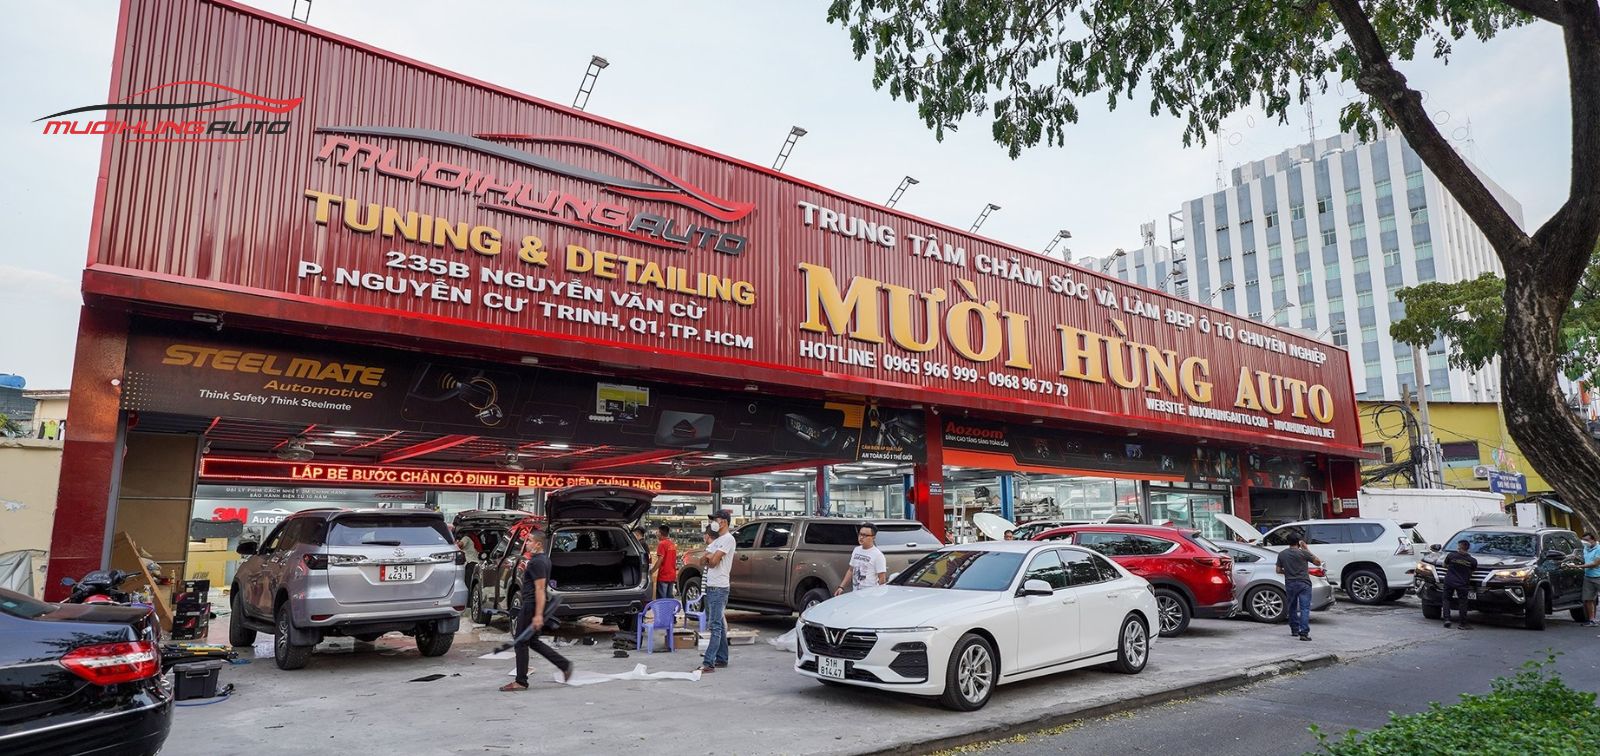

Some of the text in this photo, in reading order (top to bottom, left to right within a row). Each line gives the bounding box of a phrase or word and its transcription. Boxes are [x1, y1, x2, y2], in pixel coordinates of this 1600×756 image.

[304, 189, 756, 307] TUNING & DETAILING
[386, 251, 708, 320] 235B NGUYỄN VĂN CỪ
[798, 200, 896, 248] TRUNG
[907, 233, 966, 268] TÂM
[975, 256, 1043, 288] CHĂM
[1095, 285, 1120, 311] VÀ
[1123, 295, 1160, 321] LÀM
[1164, 309, 1195, 332] ĐẸP
[1199, 315, 1211, 335] Ô
[1214, 321, 1235, 341] TÔ
[1237, 329, 1288, 355] CHUYÊN
[1289, 343, 1328, 368] NGHIỆP
[298, 260, 327, 282] P.
[335, 267, 472, 305] NGUYỄN
[483, 292, 529, 313] CƯ
[704, 329, 754, 350] HCM
[799, 261, 1335, 425] MƯỜI HÙNG AUTO
[264, 380, 374, 400] Automotive
[883, 353, 920, 375] 0965
[923, 360, 950, 380] 966
[952, 365, 978, 384] 999
[988, 371, 1020, 390] 0968
[1021, 377, 1038, 393] 96
[1037, 380, 1053, 394] 79
[1054, 382, 1069, 397] 79
[199, 389, 352, 411] Think Safety Think Steelmate
[945, 421, 1005, 440] Aozoom
[211, 507, 249, 525] 3M
[393, 565, 408, 573] 51H
[825, 657, 838, 668] 51H
